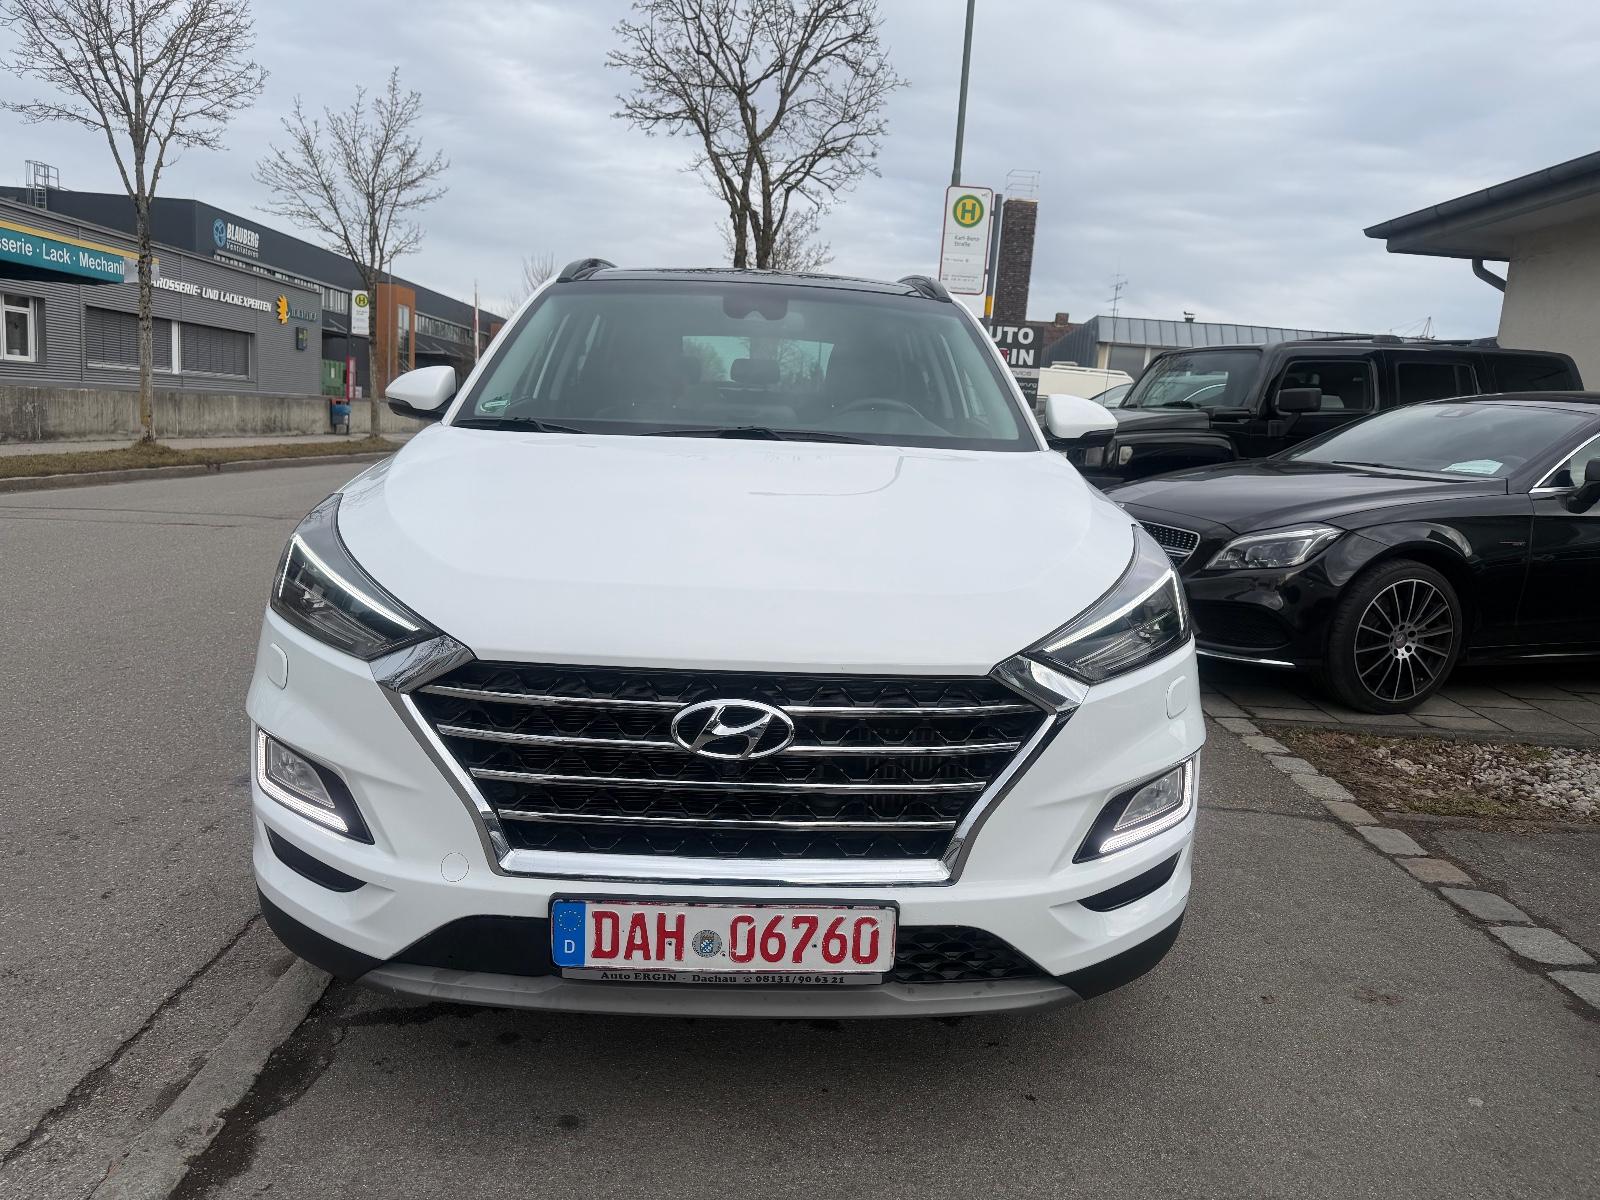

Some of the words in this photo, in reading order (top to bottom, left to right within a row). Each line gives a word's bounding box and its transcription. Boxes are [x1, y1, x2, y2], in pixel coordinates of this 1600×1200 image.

[961, 202, 976, 220] H
[227, 222, 259, 248] BLAUBERG
[42, 242, 71, 265] Lack
[151, 277, 201, 296] AROSSERIE-
[203, 287, 219, 301] UND
[221, 292, 272, 312] LACKEXPERTEN
[989, 326, 1034, 344] UTO
[564, 941, 575, 954] D
[591, 911, 686, 961] DAH
[729, 914, 880, 966] 06760
[600, 972, 630, 980] Auto
[634, 973, 677, 981] ERGIN
[692, 974, 737, 983] Dachau
